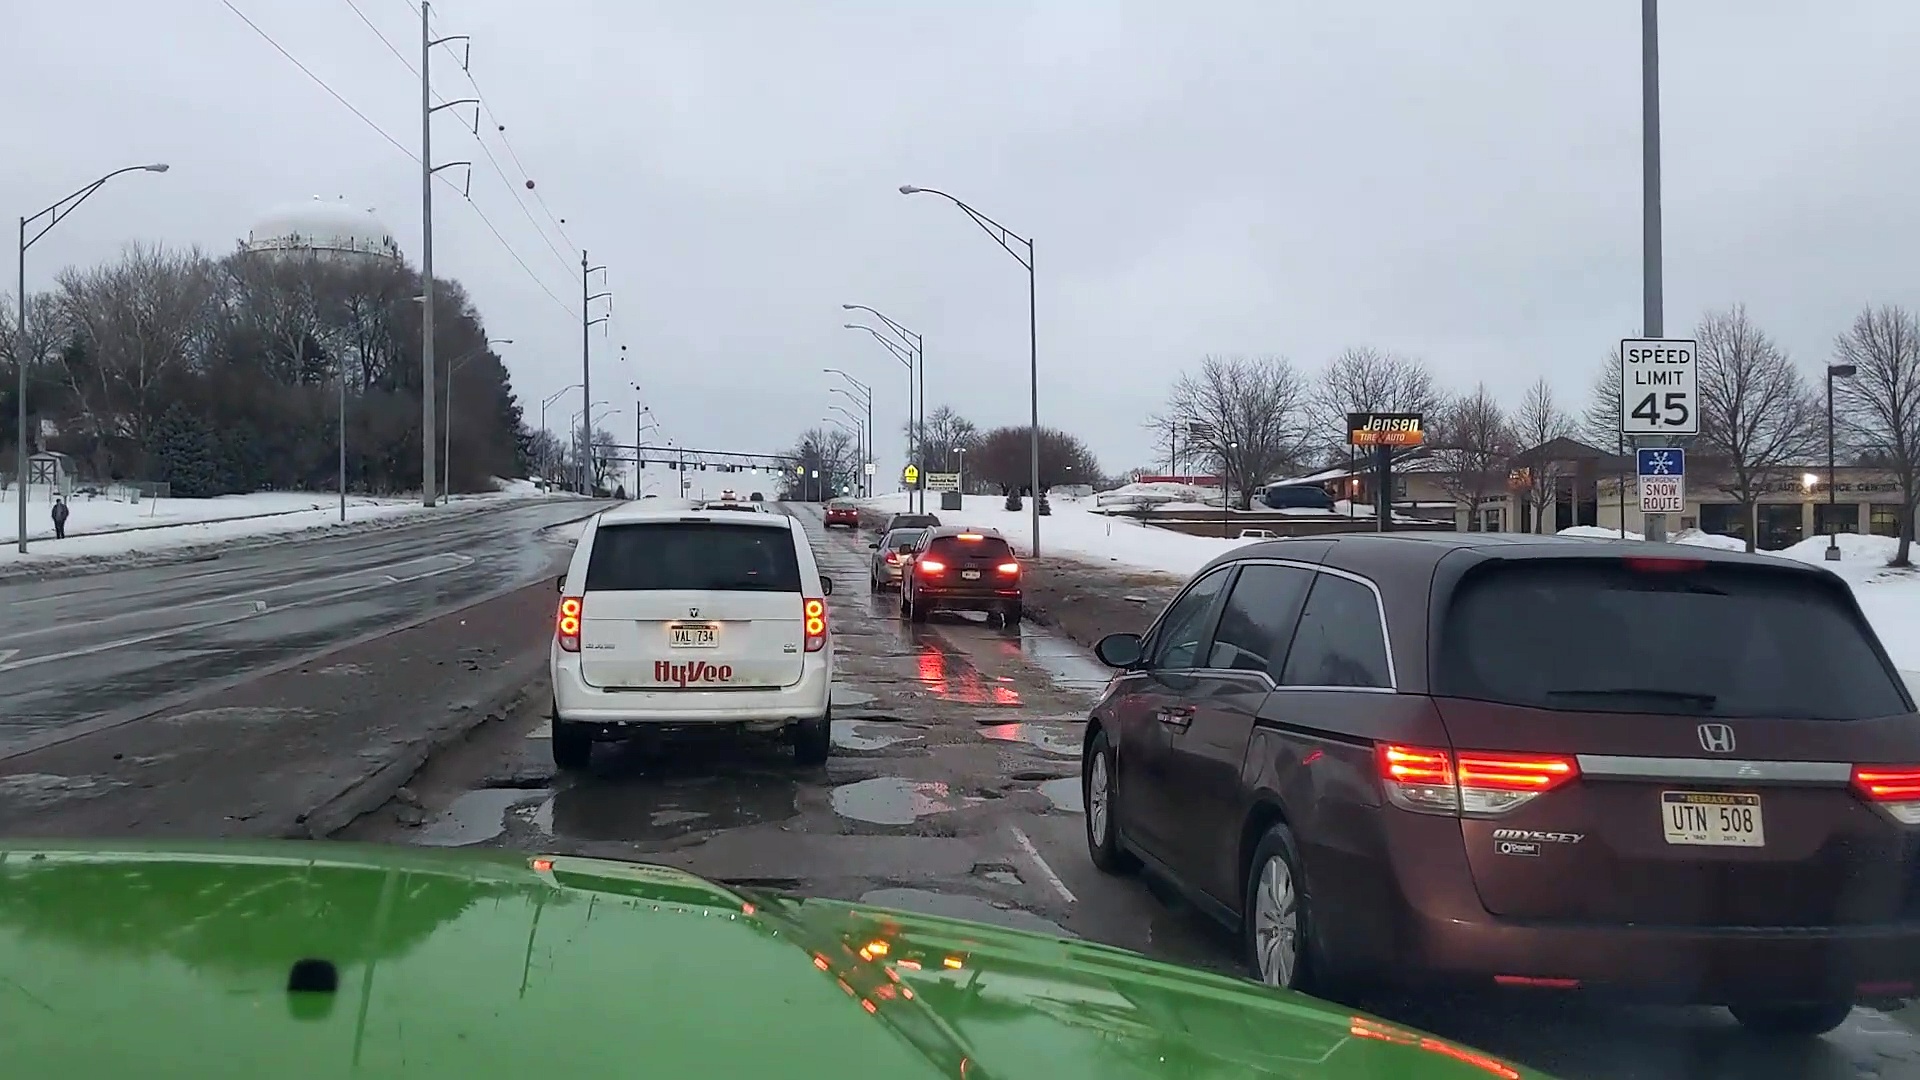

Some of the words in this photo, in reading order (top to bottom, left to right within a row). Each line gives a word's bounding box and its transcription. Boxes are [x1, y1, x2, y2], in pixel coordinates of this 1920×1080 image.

[1629, 349, 1690, 364] SPEED
[1636, 371, 1684, 385] LIMIT
[1631, 392, 1689, 426] 45
[1362, 415, 1420, 432] Jensen
[1360, 433, 1377, 441] TIRE
[1385, 433, 1405, 442] AUTO
[1646, 484, 1677, 496] SNOW
[1643, 497, 1680, 510] ROUTE
[674, 630, 691, 642] VAL
[697, 630, 714, 642] 734
[1672, 805, 1707, 831] UTN
[1720, 807, 1753, 832] 508
[1493, 829, 1585, 844] ODYSSEY
